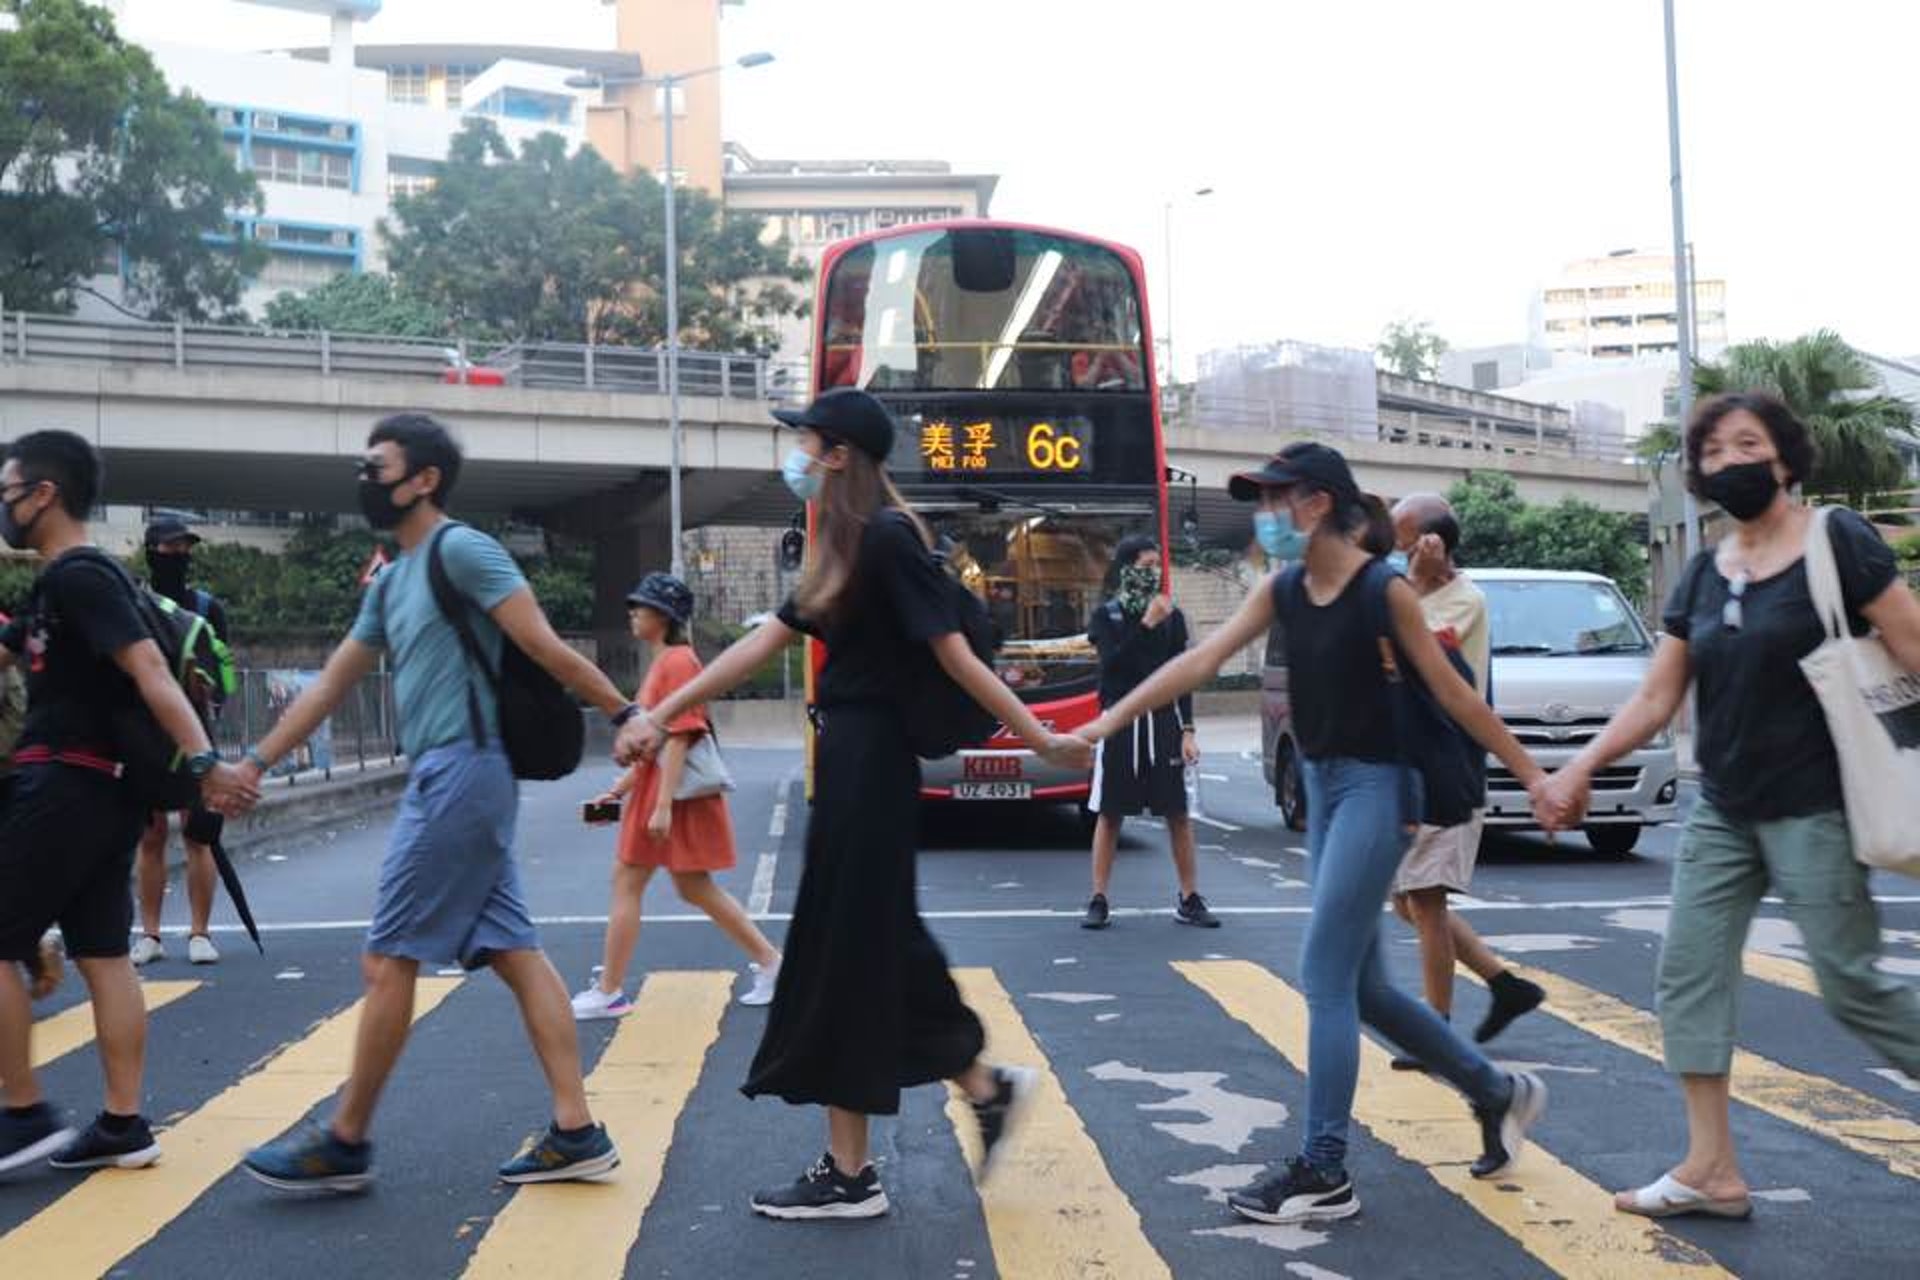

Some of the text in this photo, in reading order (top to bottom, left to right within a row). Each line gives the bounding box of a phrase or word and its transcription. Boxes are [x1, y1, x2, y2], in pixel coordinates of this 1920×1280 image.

[921, 422, 997, 456] 美孚
[963, 455, 987, 469] FOO
[963, 756, 1023, 778] KMB
